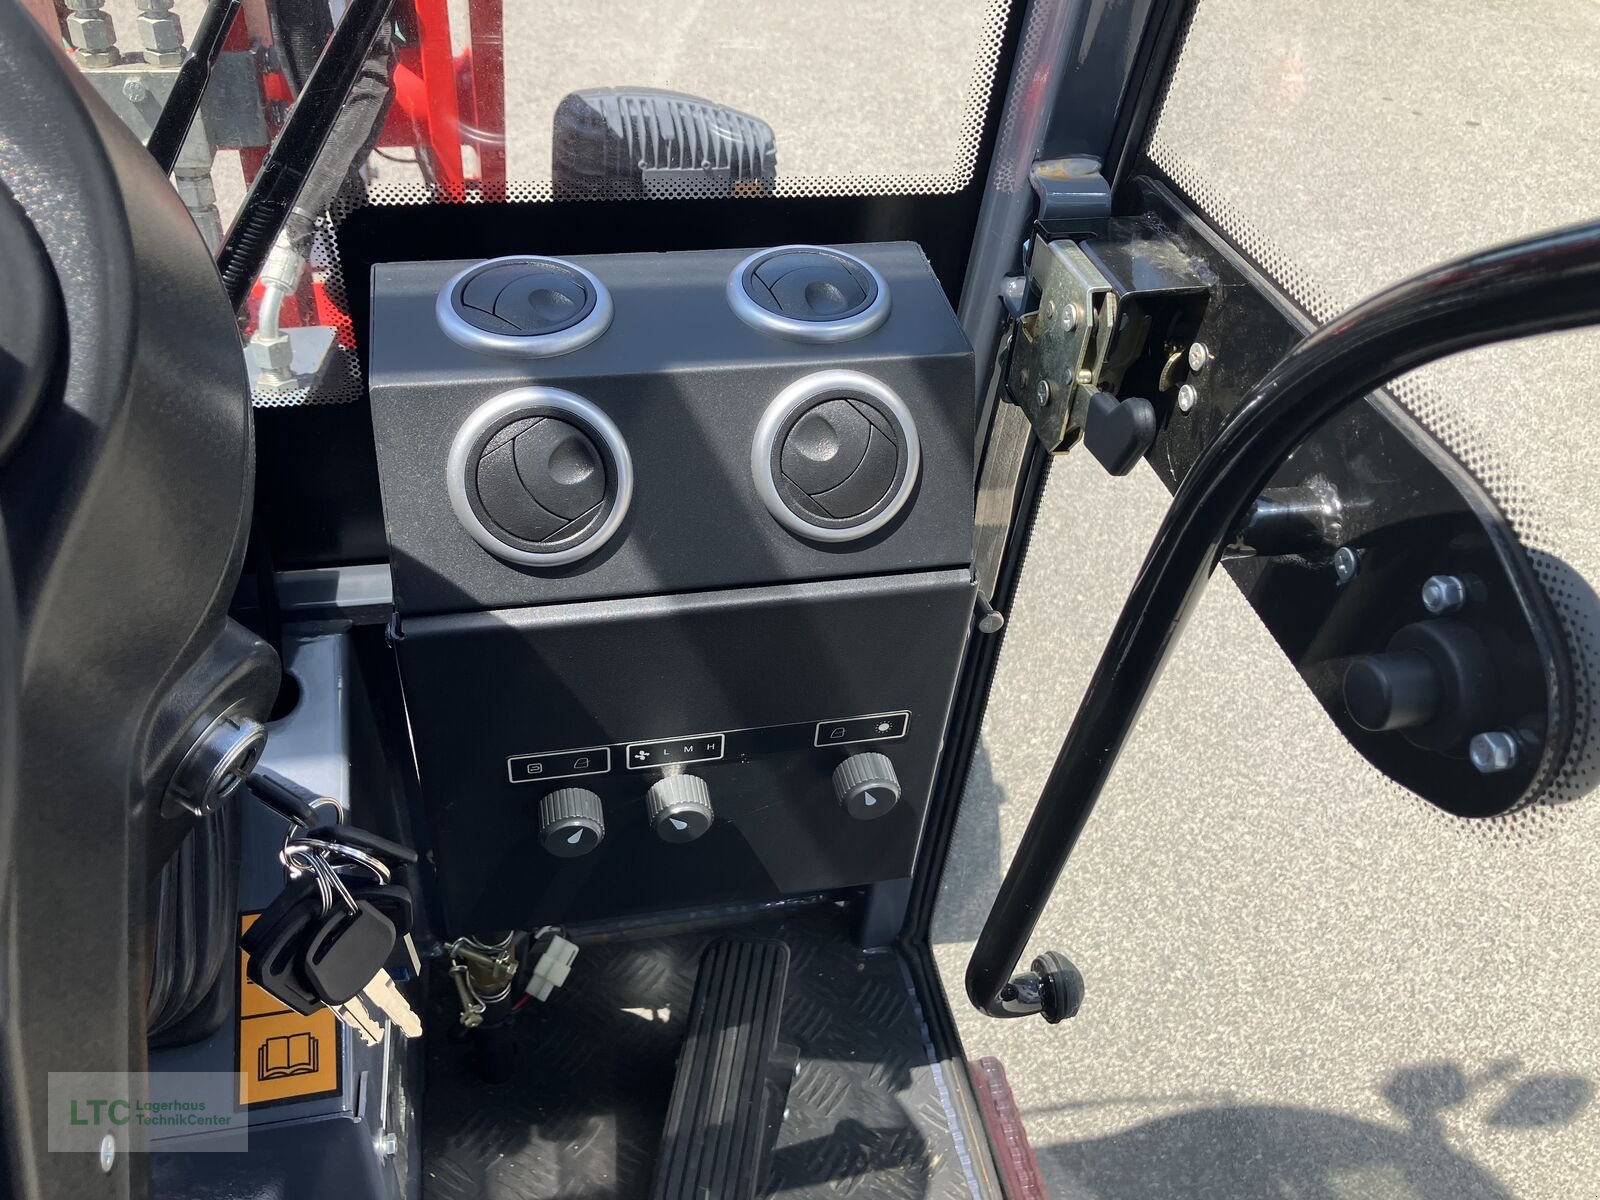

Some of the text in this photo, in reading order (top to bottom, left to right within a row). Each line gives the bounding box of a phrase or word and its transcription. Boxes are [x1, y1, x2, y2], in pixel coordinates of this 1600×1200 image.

[663, 743, 715, 756] L M H
